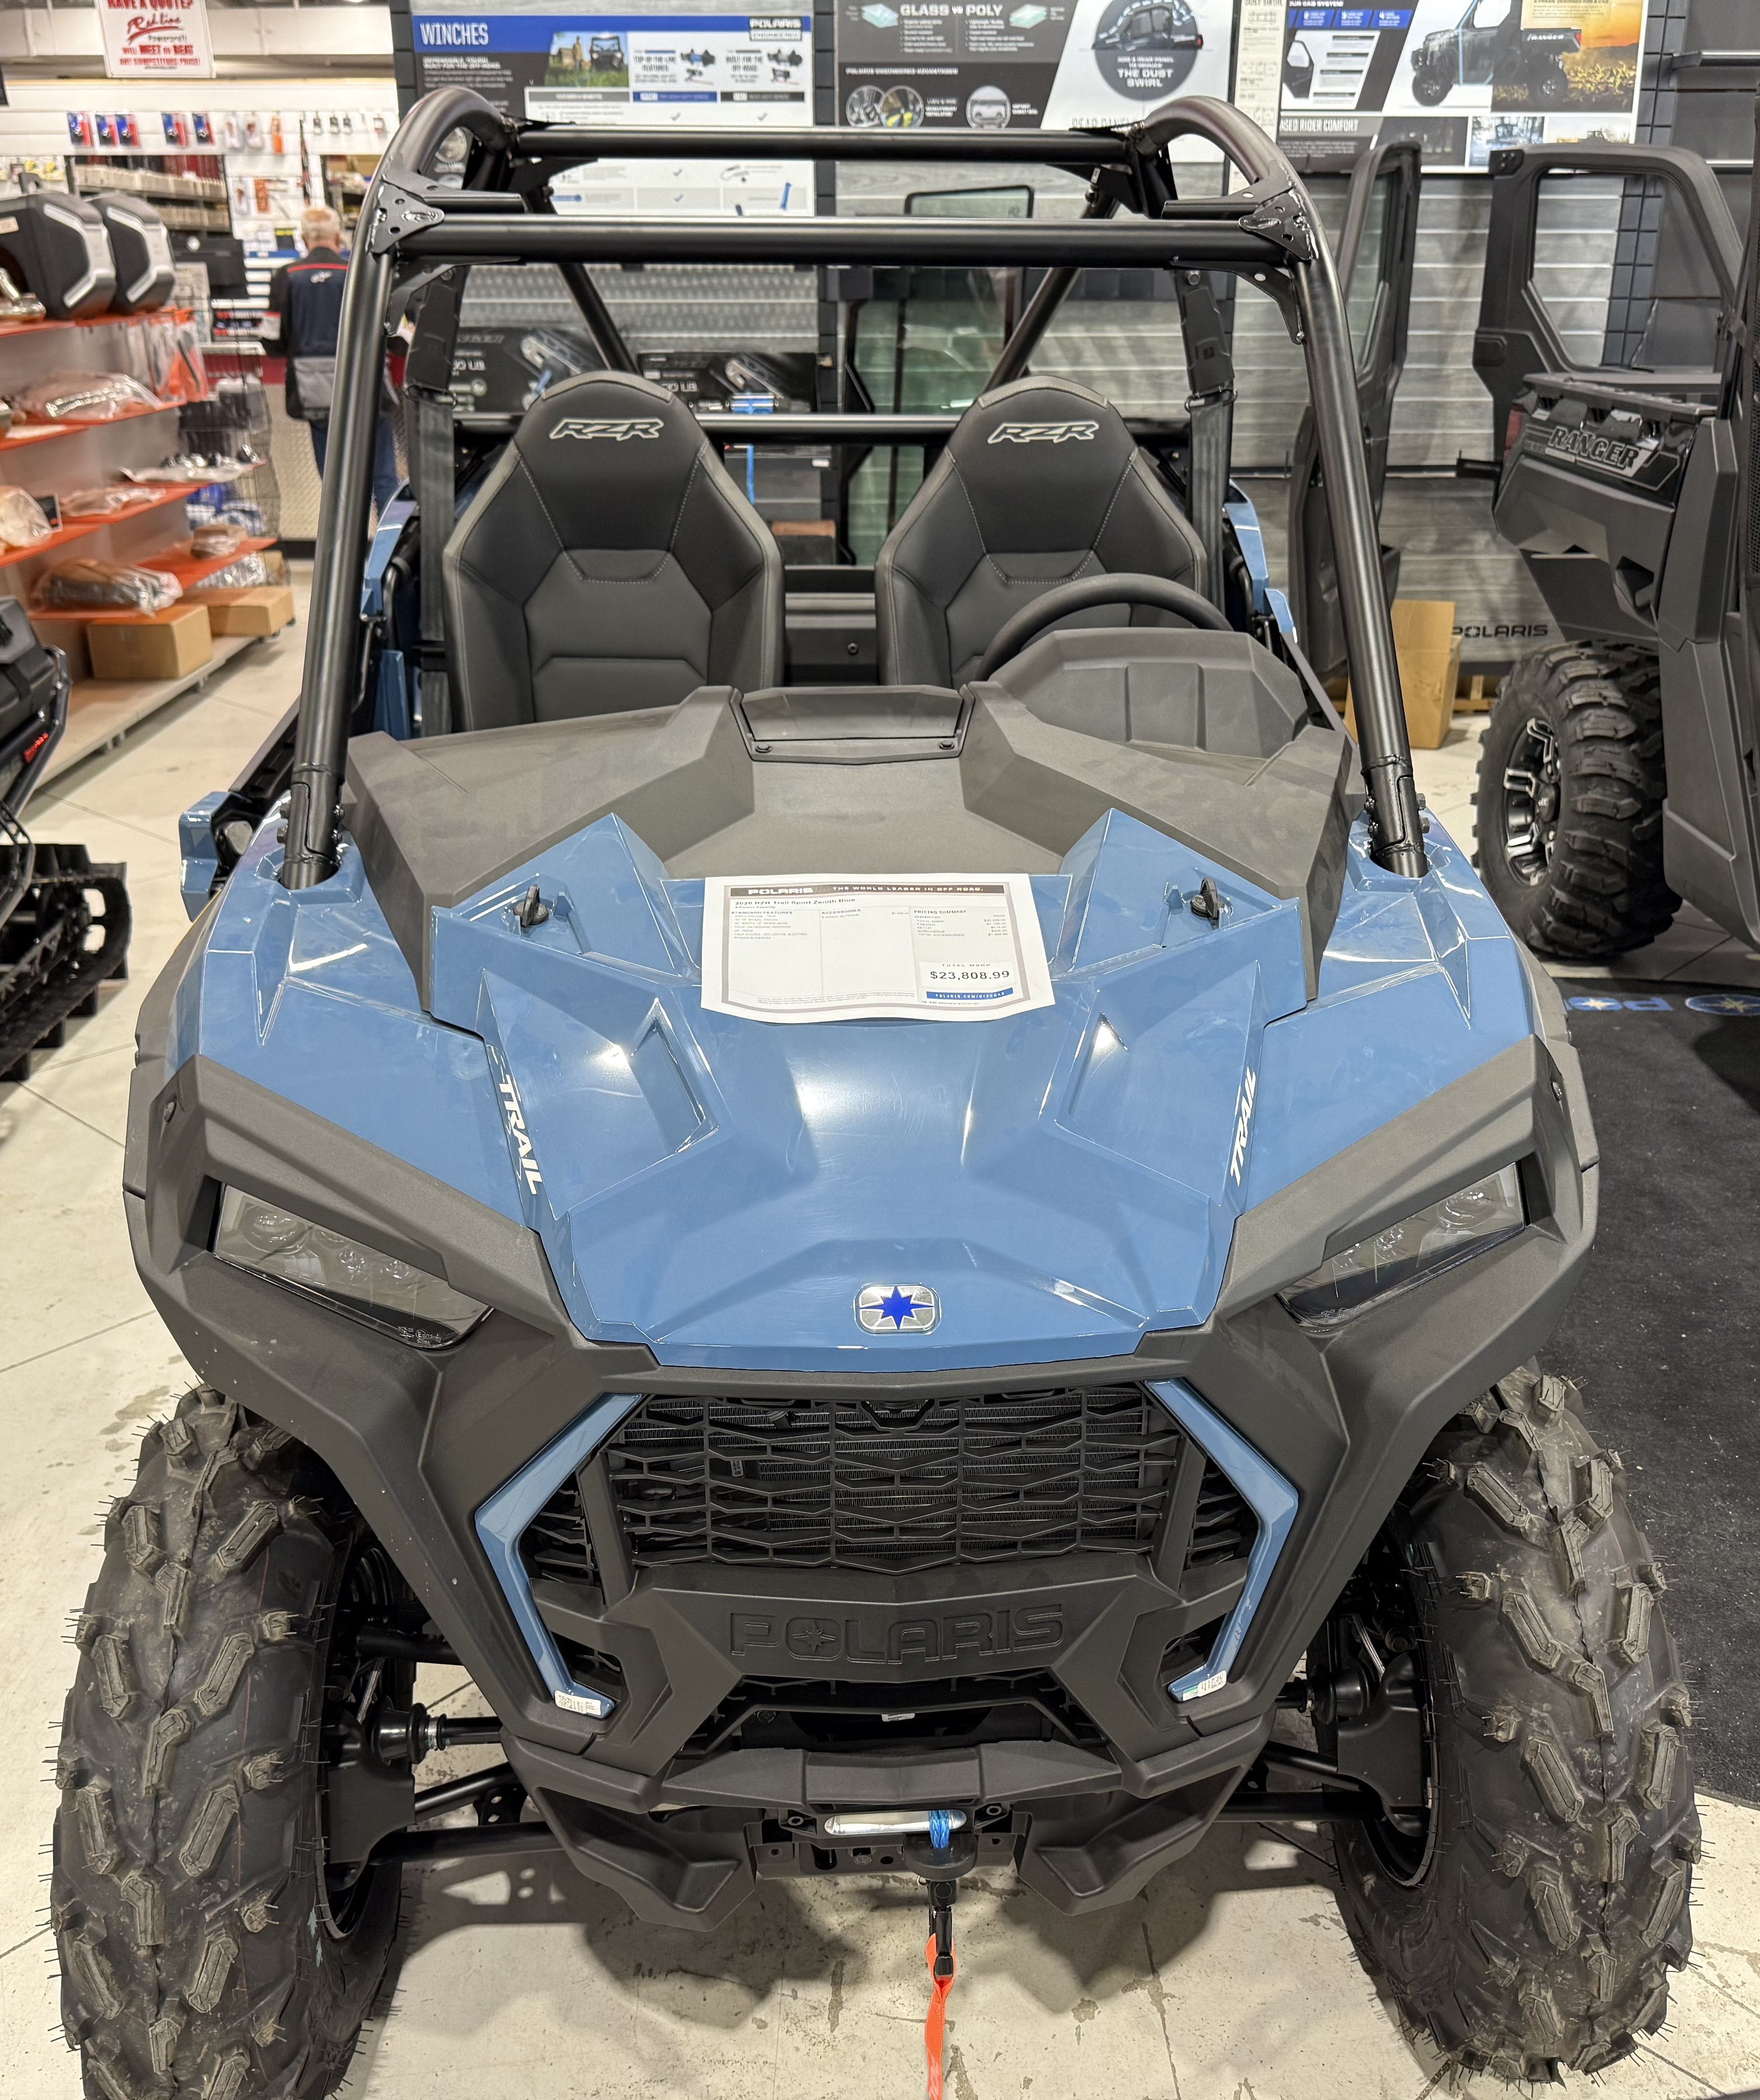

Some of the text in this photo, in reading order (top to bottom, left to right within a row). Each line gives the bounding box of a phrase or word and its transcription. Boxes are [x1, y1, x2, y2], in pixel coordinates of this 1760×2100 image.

[900, 4, 949, 16] GLASS
[966, 4, 1003, 16] POLY
[420, 22, 489, 45] WINCHES
[1117, 69, 1174, 78] THE DUST
[1323, 119, 1358, 132] COMFORT
[549, 419, 664, 441] RZR
[988, 421, 1099, 444] RZR
[1548, 425, 1639, 470] RANGER
[1452, 624, 1548, 638] POLARIS
[930, 971, 1010, 981] $23,808.99
[498, 1074, 543, 1195] TRAIL
[1230, 1066, 1256, 1187] TRAIL
[730, 1603, 1064, 1665] POLARIS
